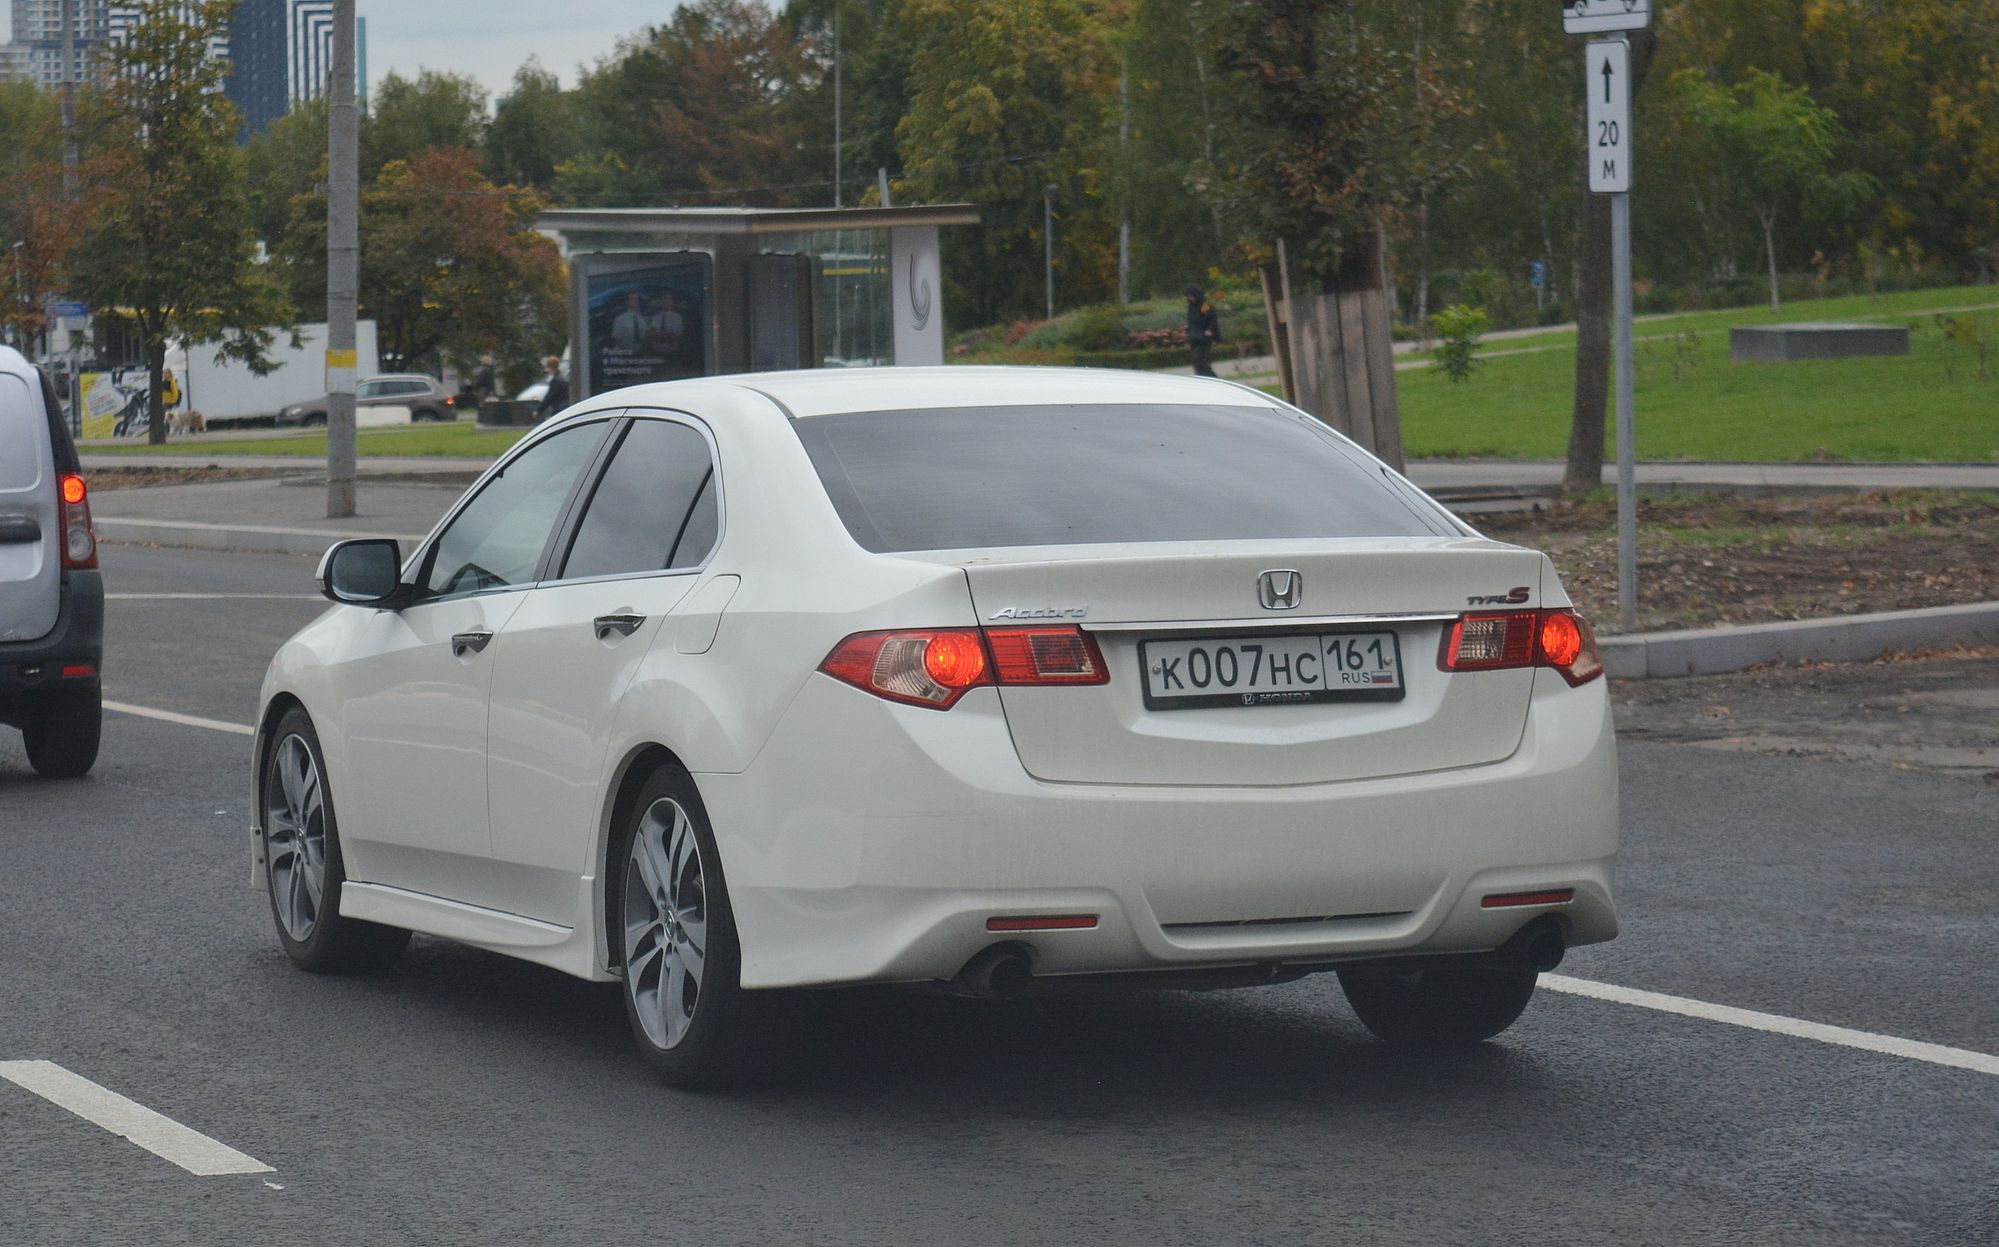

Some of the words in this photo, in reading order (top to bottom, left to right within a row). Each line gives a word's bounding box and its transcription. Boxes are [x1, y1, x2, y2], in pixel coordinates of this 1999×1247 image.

[1598, 120, 1618, 147] 20
[987, 605, 1089, 621] Accord
[1326, 638, 1384, 671] 161
[1342, 672, 1371, 684] RUS
[1259, 692, 1311, 703] HONDA
